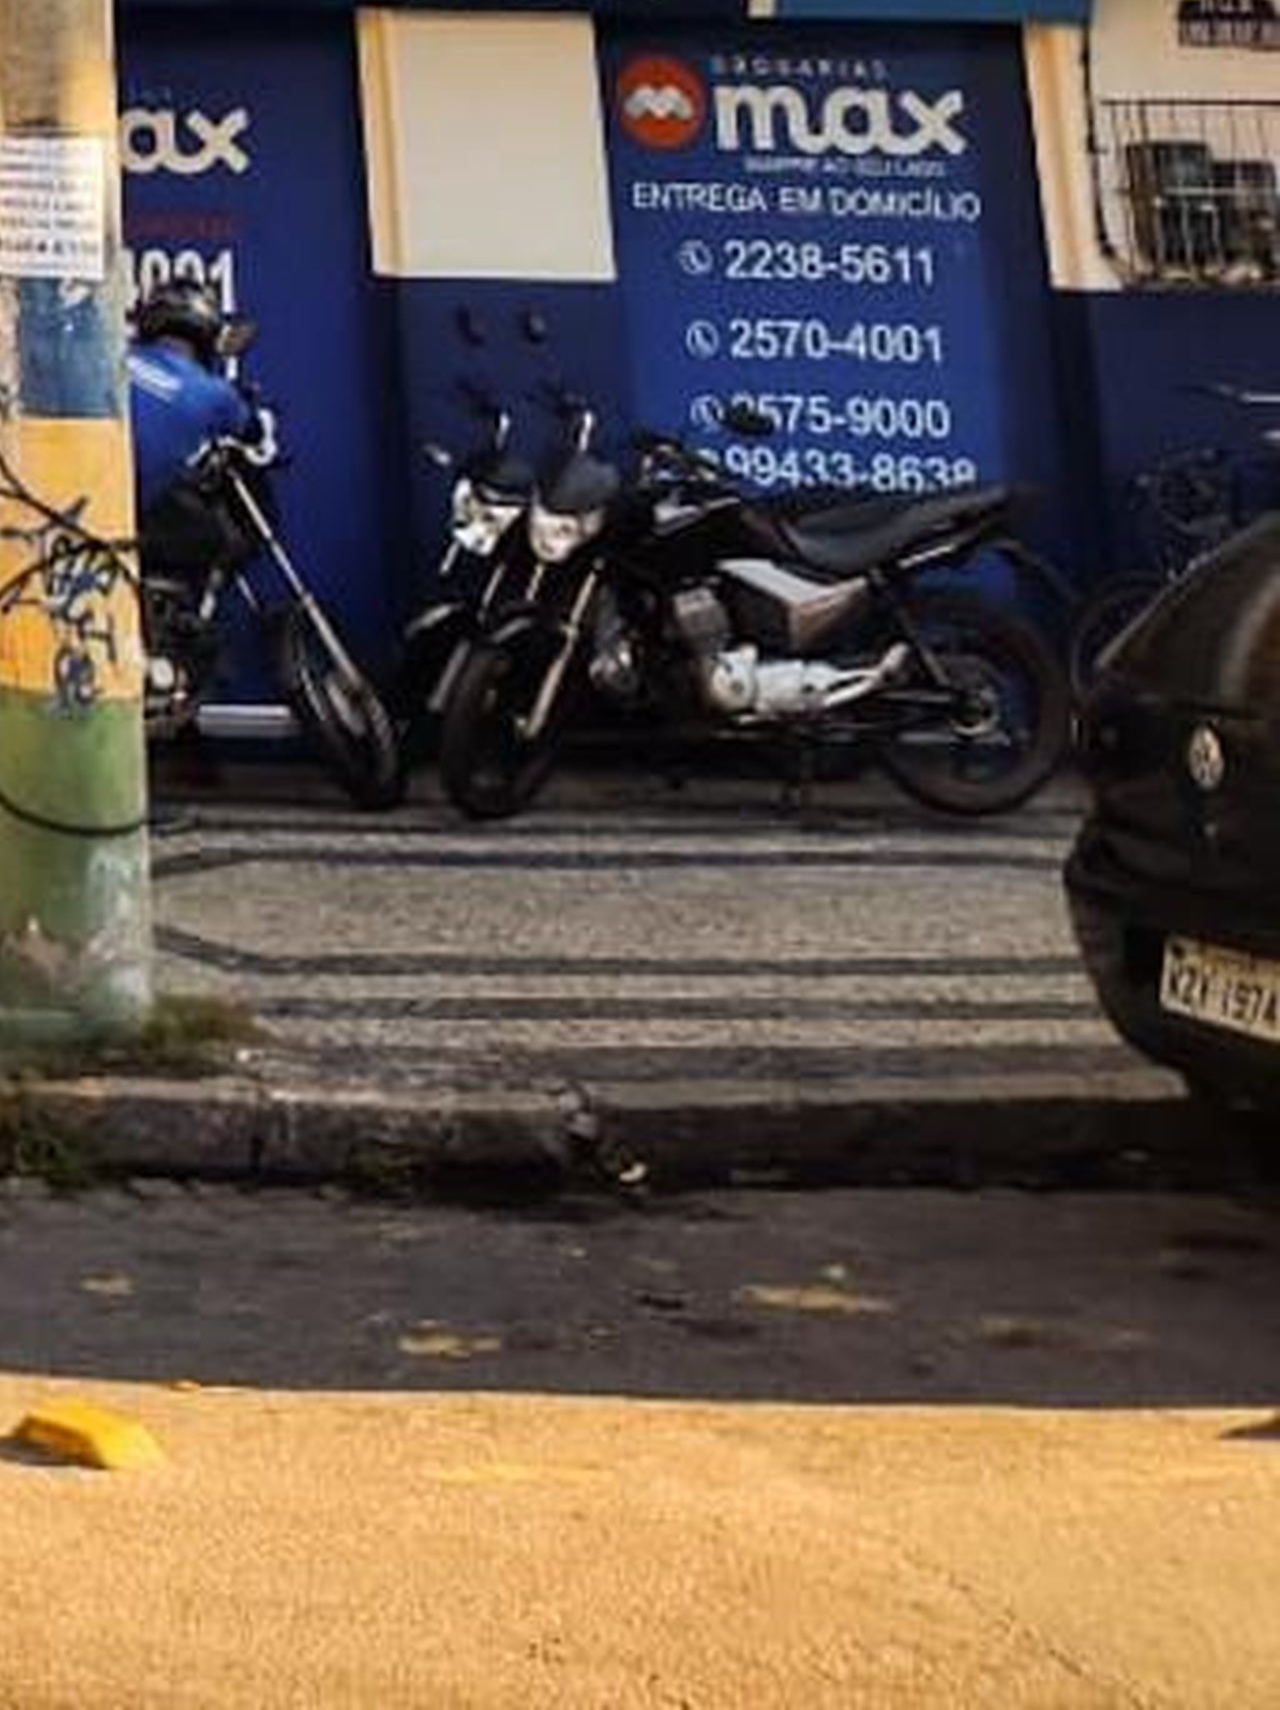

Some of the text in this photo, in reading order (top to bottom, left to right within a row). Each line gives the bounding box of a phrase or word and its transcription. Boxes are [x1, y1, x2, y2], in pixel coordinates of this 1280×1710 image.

[120, 108, 250, 174] ax
[713, 84, 967, 156] max
[633, 182, 768, 213] ENTREGA
[778, 186, 821, 213] EM
[723, 239, 934, 284] 2238-5611
[728, 319, 943, 363] 2570-4001
